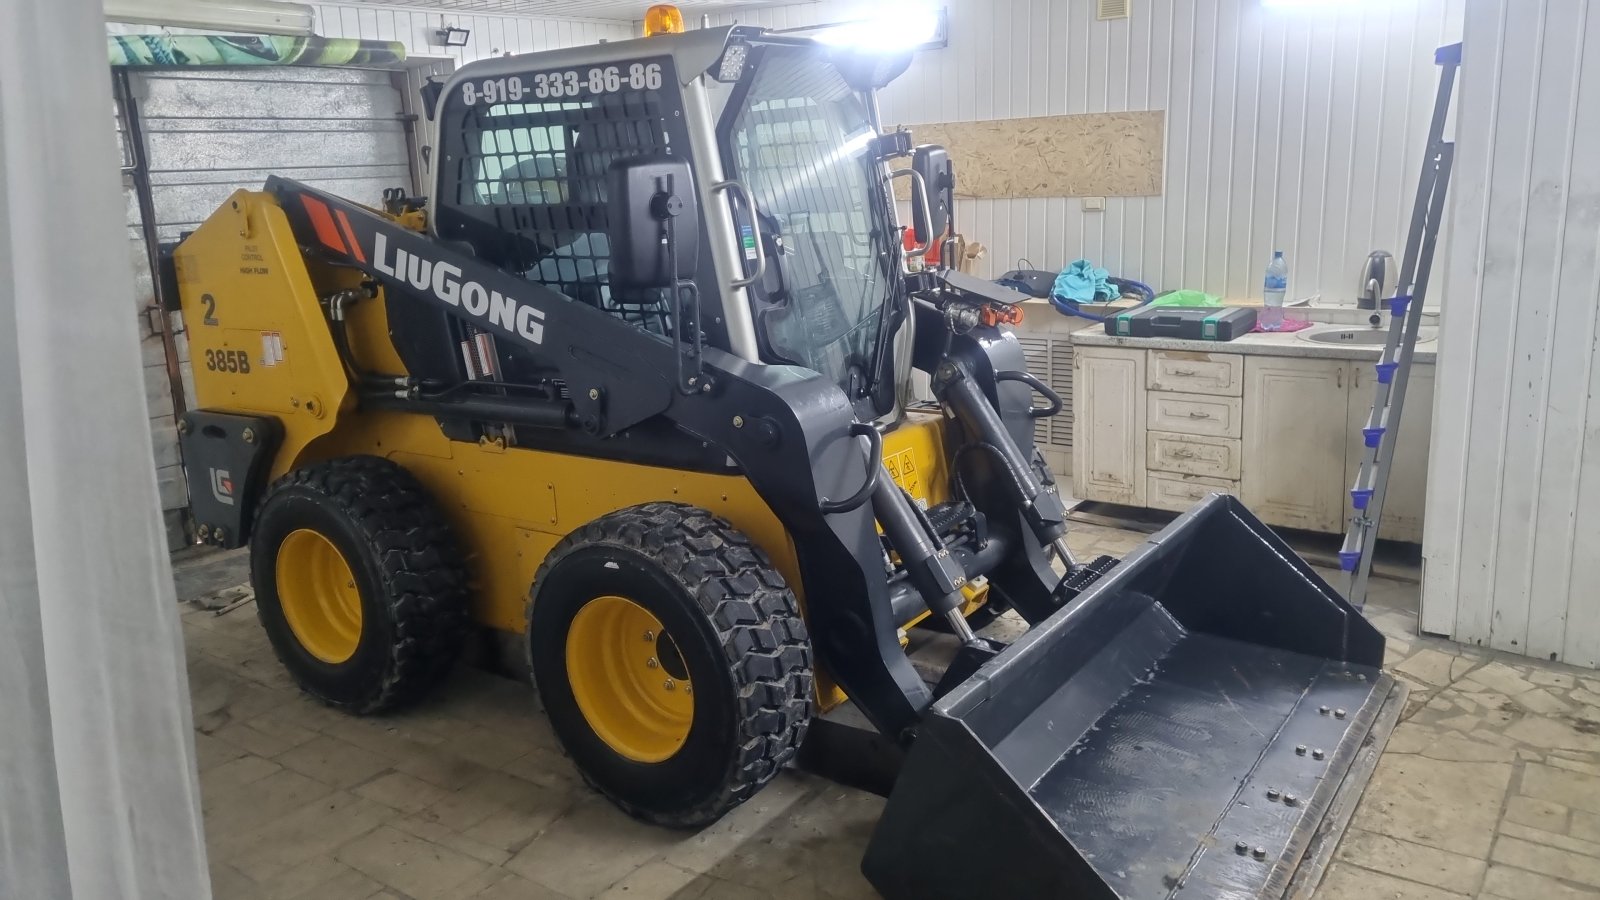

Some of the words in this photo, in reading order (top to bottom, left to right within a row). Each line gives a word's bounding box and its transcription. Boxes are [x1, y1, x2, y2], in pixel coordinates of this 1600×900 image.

[534, 63, 662, 98] 333-86-86
[201, 293, 219, 326] 2
[205, 349, 250, 374] 385B
